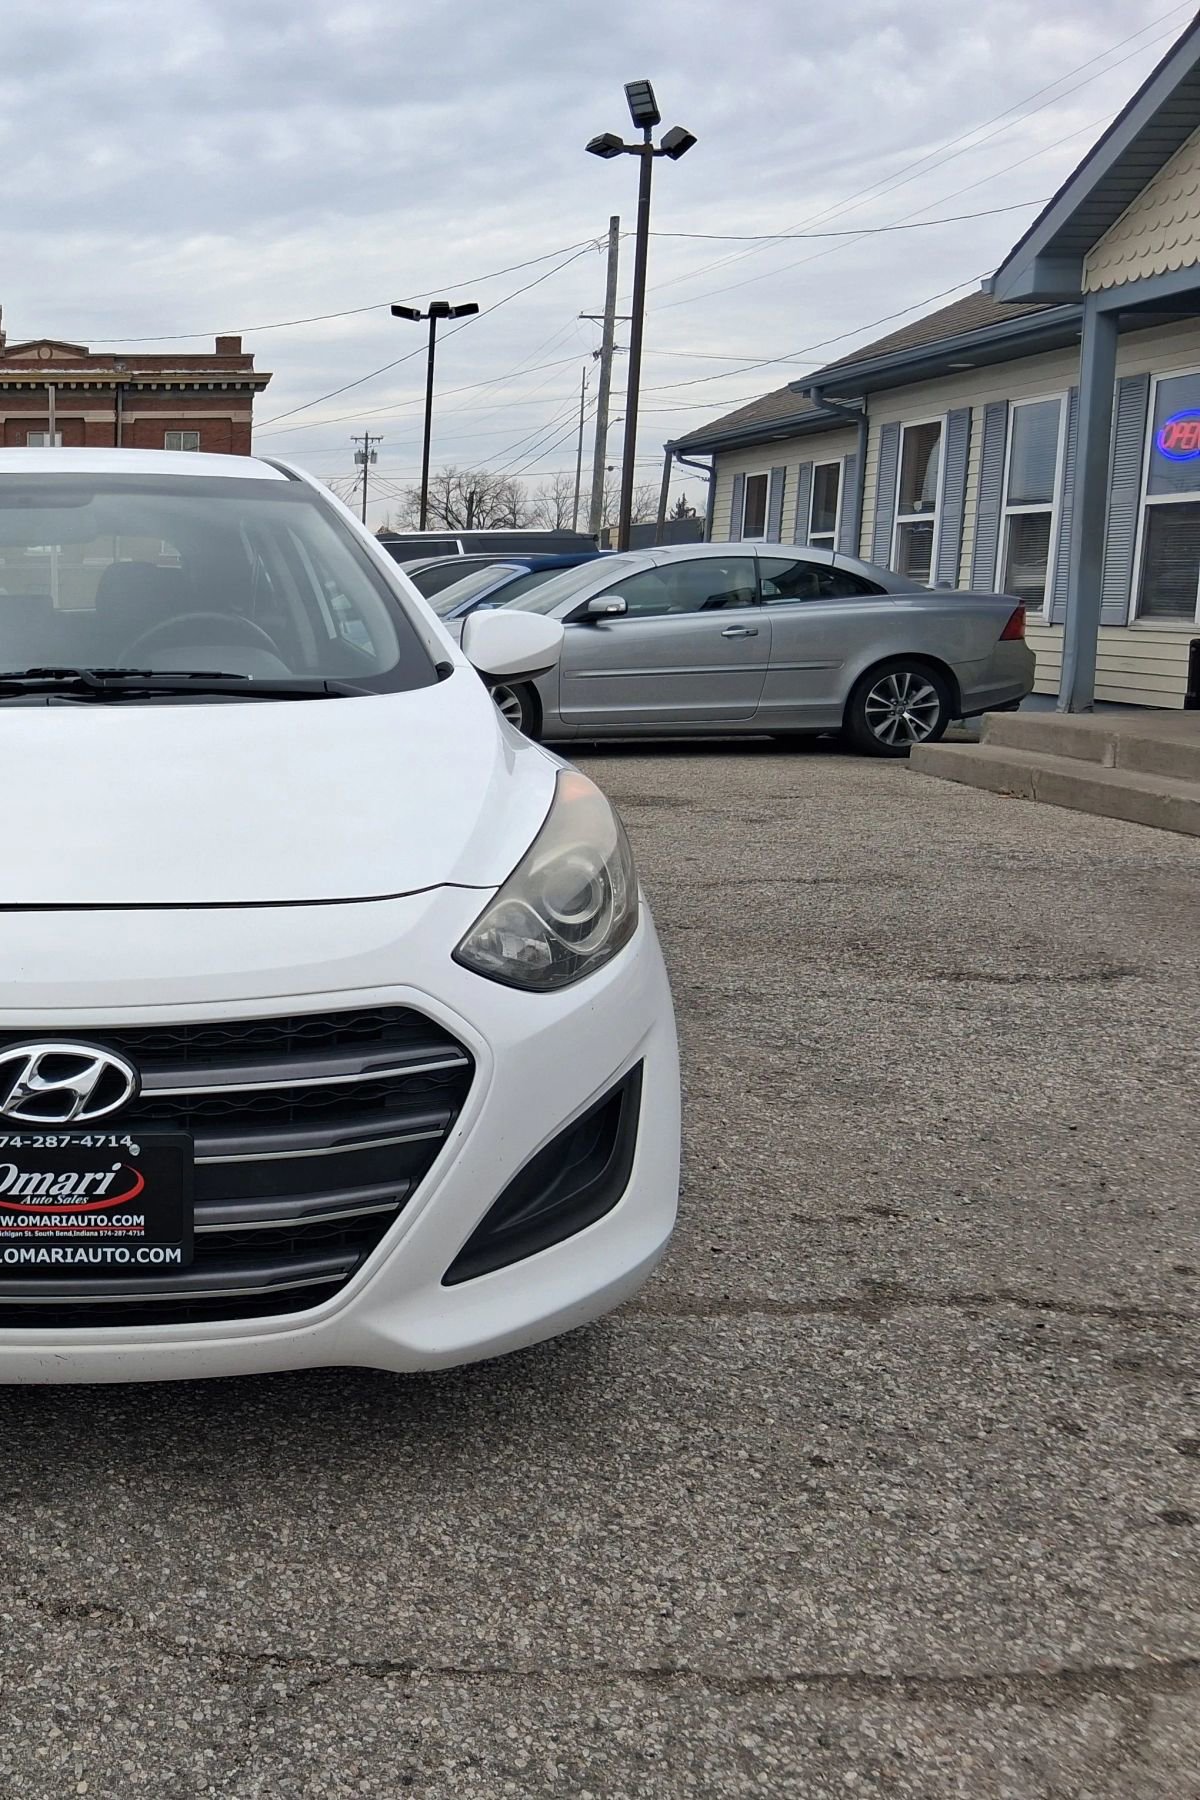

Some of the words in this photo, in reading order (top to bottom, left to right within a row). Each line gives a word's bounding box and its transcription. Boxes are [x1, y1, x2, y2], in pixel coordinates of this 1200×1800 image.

[1162, 421, 1200, 450] OPE
[20, 1195, 52, 1205] Auto
[54, 1195, 89, 1205] Sales
